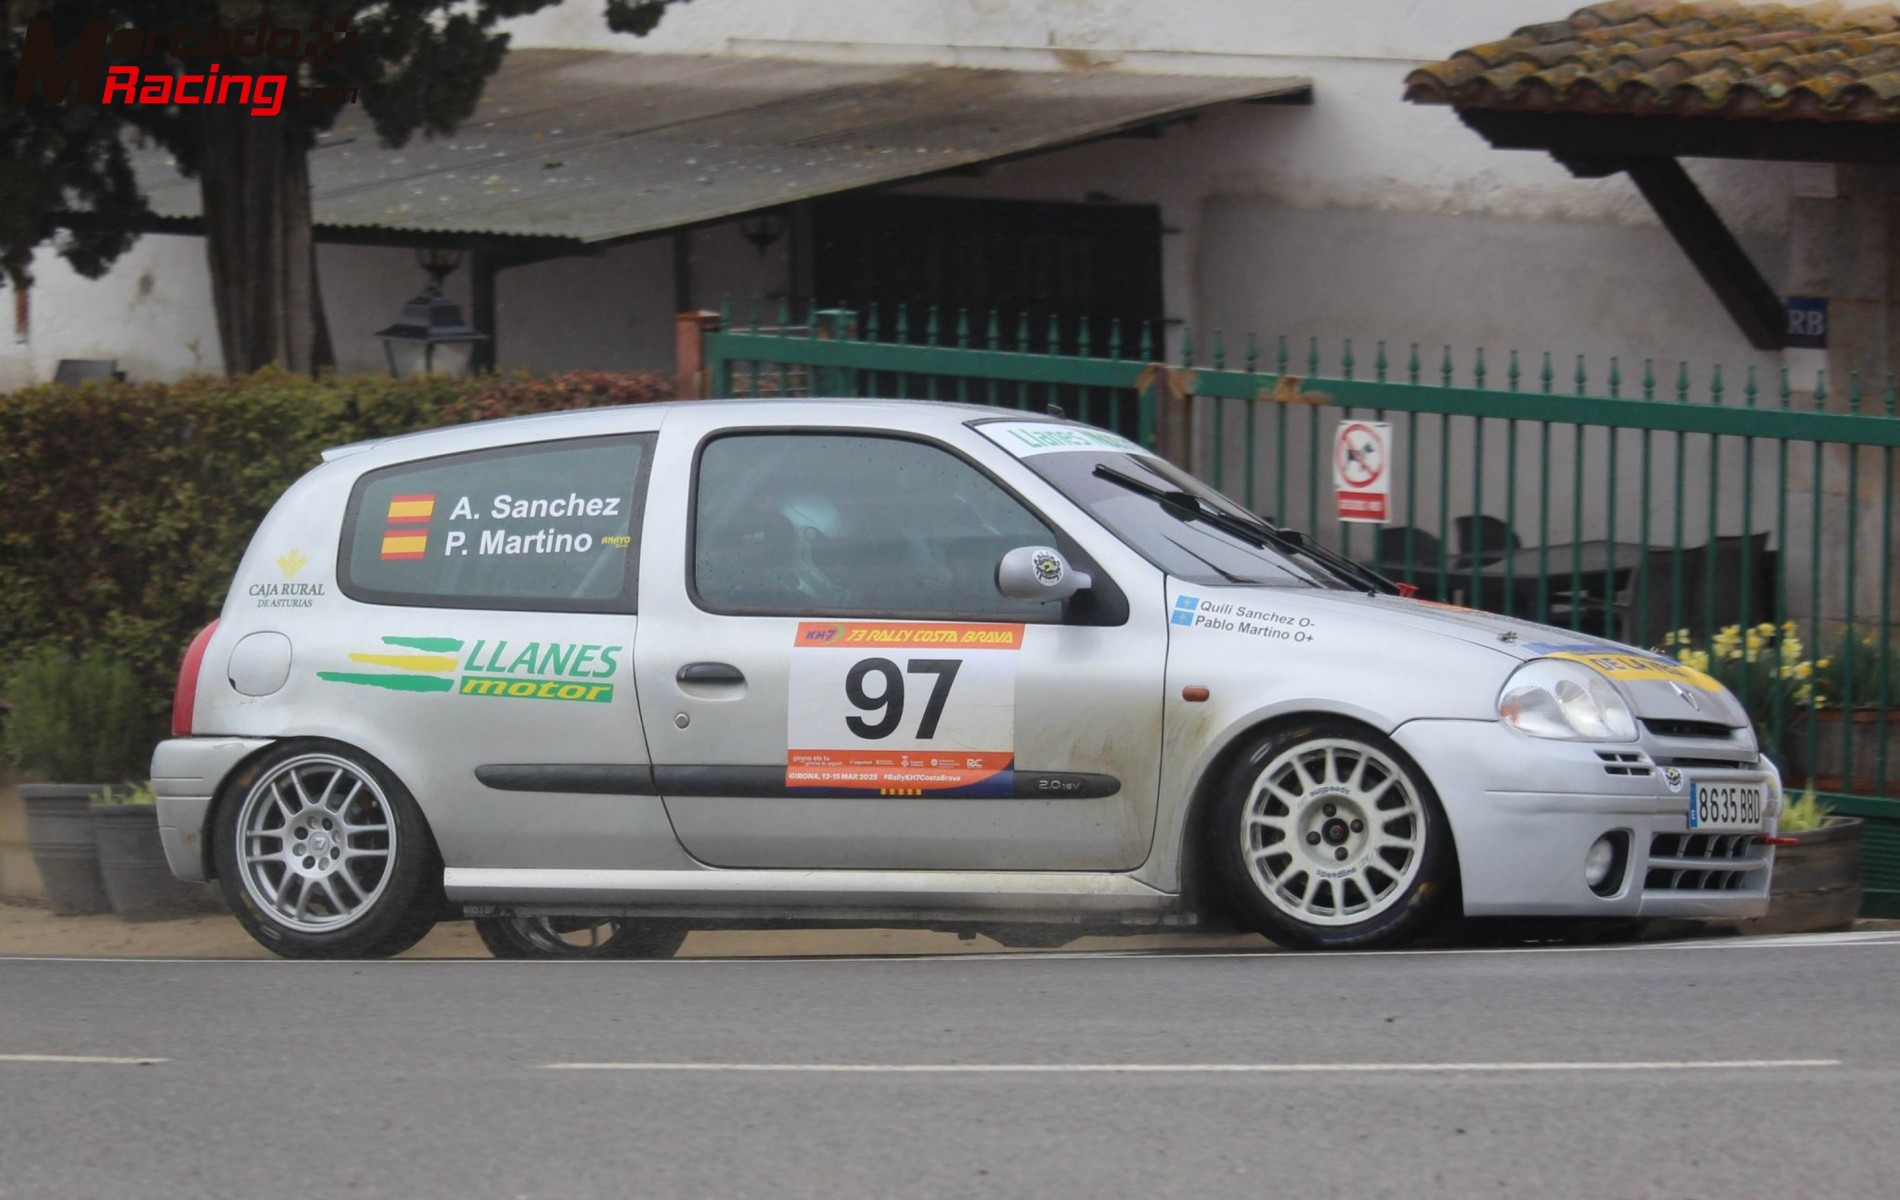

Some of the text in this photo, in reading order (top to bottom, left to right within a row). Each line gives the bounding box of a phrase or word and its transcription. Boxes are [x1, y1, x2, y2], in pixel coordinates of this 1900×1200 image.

[1007, 428, 1092, 448] Llanes
[449, 493, 621, 520] A. Sanchez
[445, 529, 593, 556] P. Martino
[249, 583, 326, 598] CAJA RURAL
[257, 599, 313, 608] DE ASTURIAS
[1200, 600, 1233, 615] Quili
[1235, 606, 1296, 626] Sanchez
[846, 630, 1013, 643] 73 RALLY COSTA BRAVA
[1195, 615, 1314, 643] Pablo Martino O+
[463, 639, 623, 678] LLANES
[461, 678, 611, 701] motor
[845, 657, 963, 740] 97
[788, 773, 821, 781] GIRONA,
[1038, 780, 1061, 790] 2.0
[1699, 787, 1760, 824] 8635 BBD
